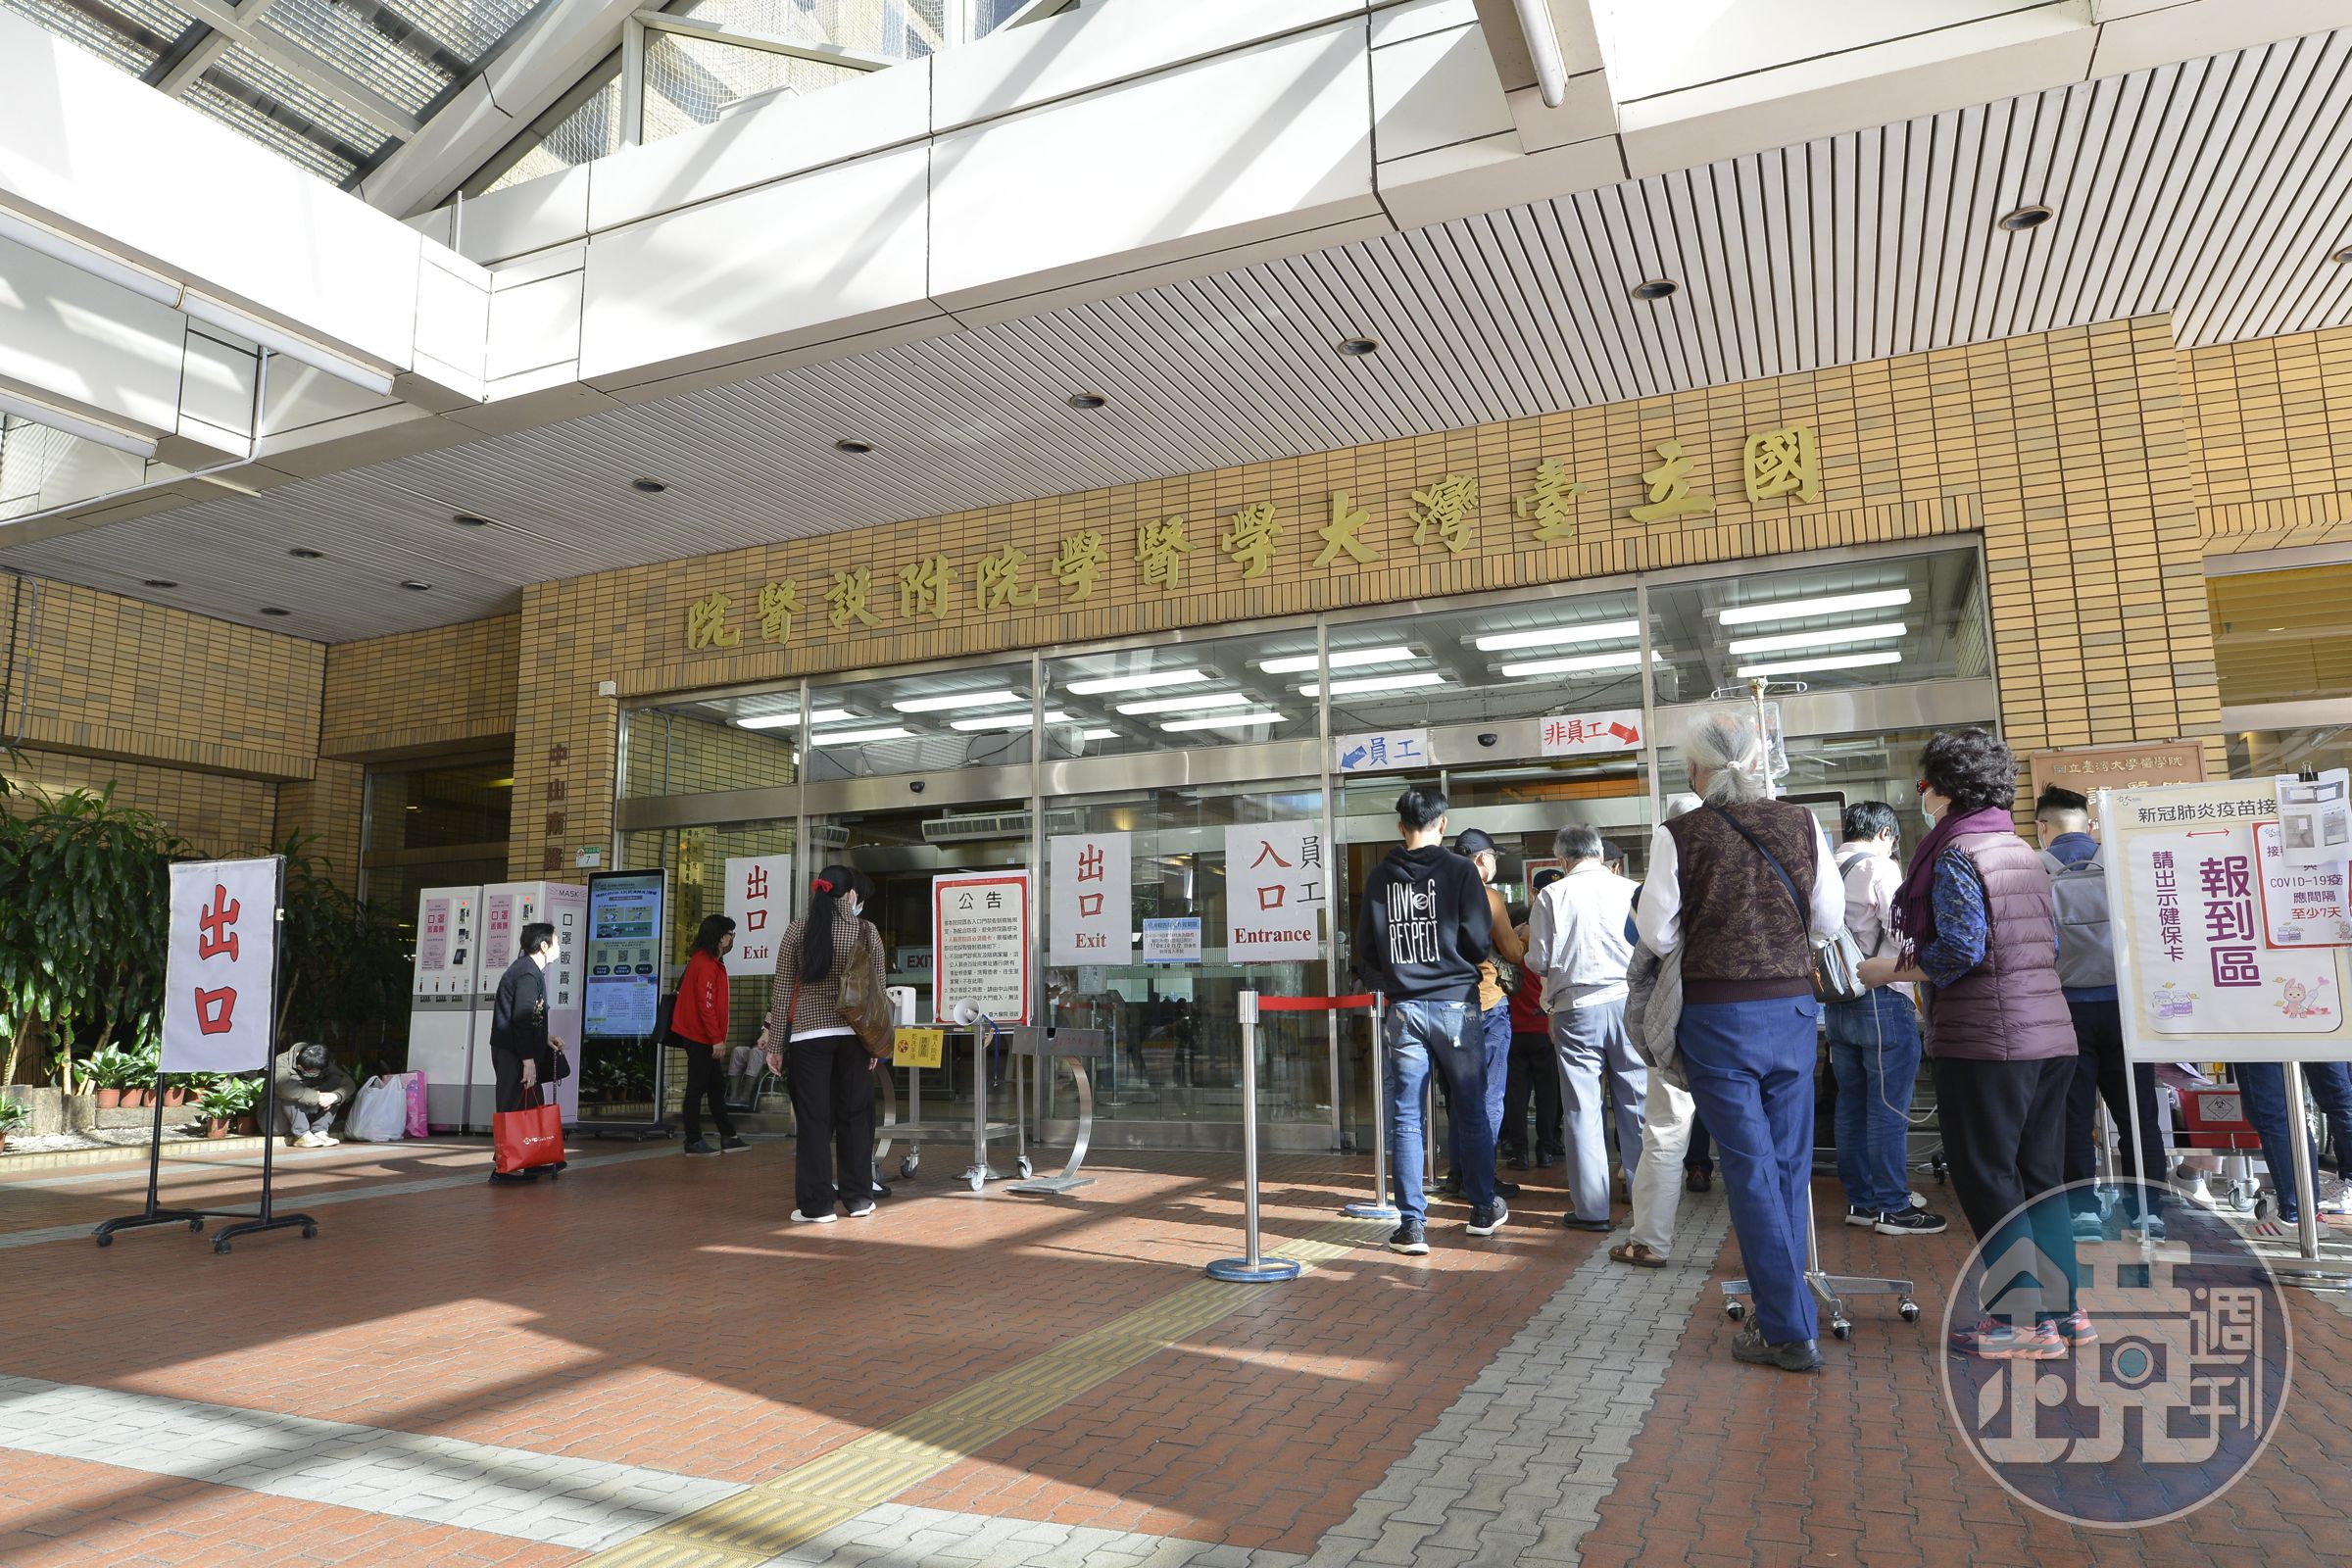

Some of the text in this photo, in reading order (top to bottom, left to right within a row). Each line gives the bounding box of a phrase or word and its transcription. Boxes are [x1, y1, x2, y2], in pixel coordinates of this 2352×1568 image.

[1544, 719, 1608, 746] 非員工
[1369, 736, 1421, 766] 員工
[2053, 755, 2184, 775] 國立臺灣大學醫學院
[2137, 798, 2278, 824] 新冠肺炎疫苗接
[585, 855, 592, 864] 7
[2267, 846, 2283, 858] 接
[1077, 843, 1104, 918] 出口
[1250, 840, 1293, 911] 入口
[1297, 835, 1326, 904] 員工
[746, 864, 768, 933] 出口
[958, 891, 1003, 910] 公告
[1387, 882, 1418, 923] LOVE
[2151, 851, 2184, 963] 請出示健保卡
[2293, 890, 2336, 904] 應間隔
[427, 913, 445, 924] 口罩
[491, 909, 509, 920] 口罩
[2199, 855, 2262, 988] 報到區
[2291, 906, 2342, 919] 至少7天
[1074, 932, 1107, 949] Exit
[1234, 927, 1312, 944] Entrance
[1389, 920, 1441, 964] RESPECT
[194, 883, 241, 1036] 出口
[558, 913, 573, 1004] 口罩販賣機
[743, 945, 769, 959] Exit
